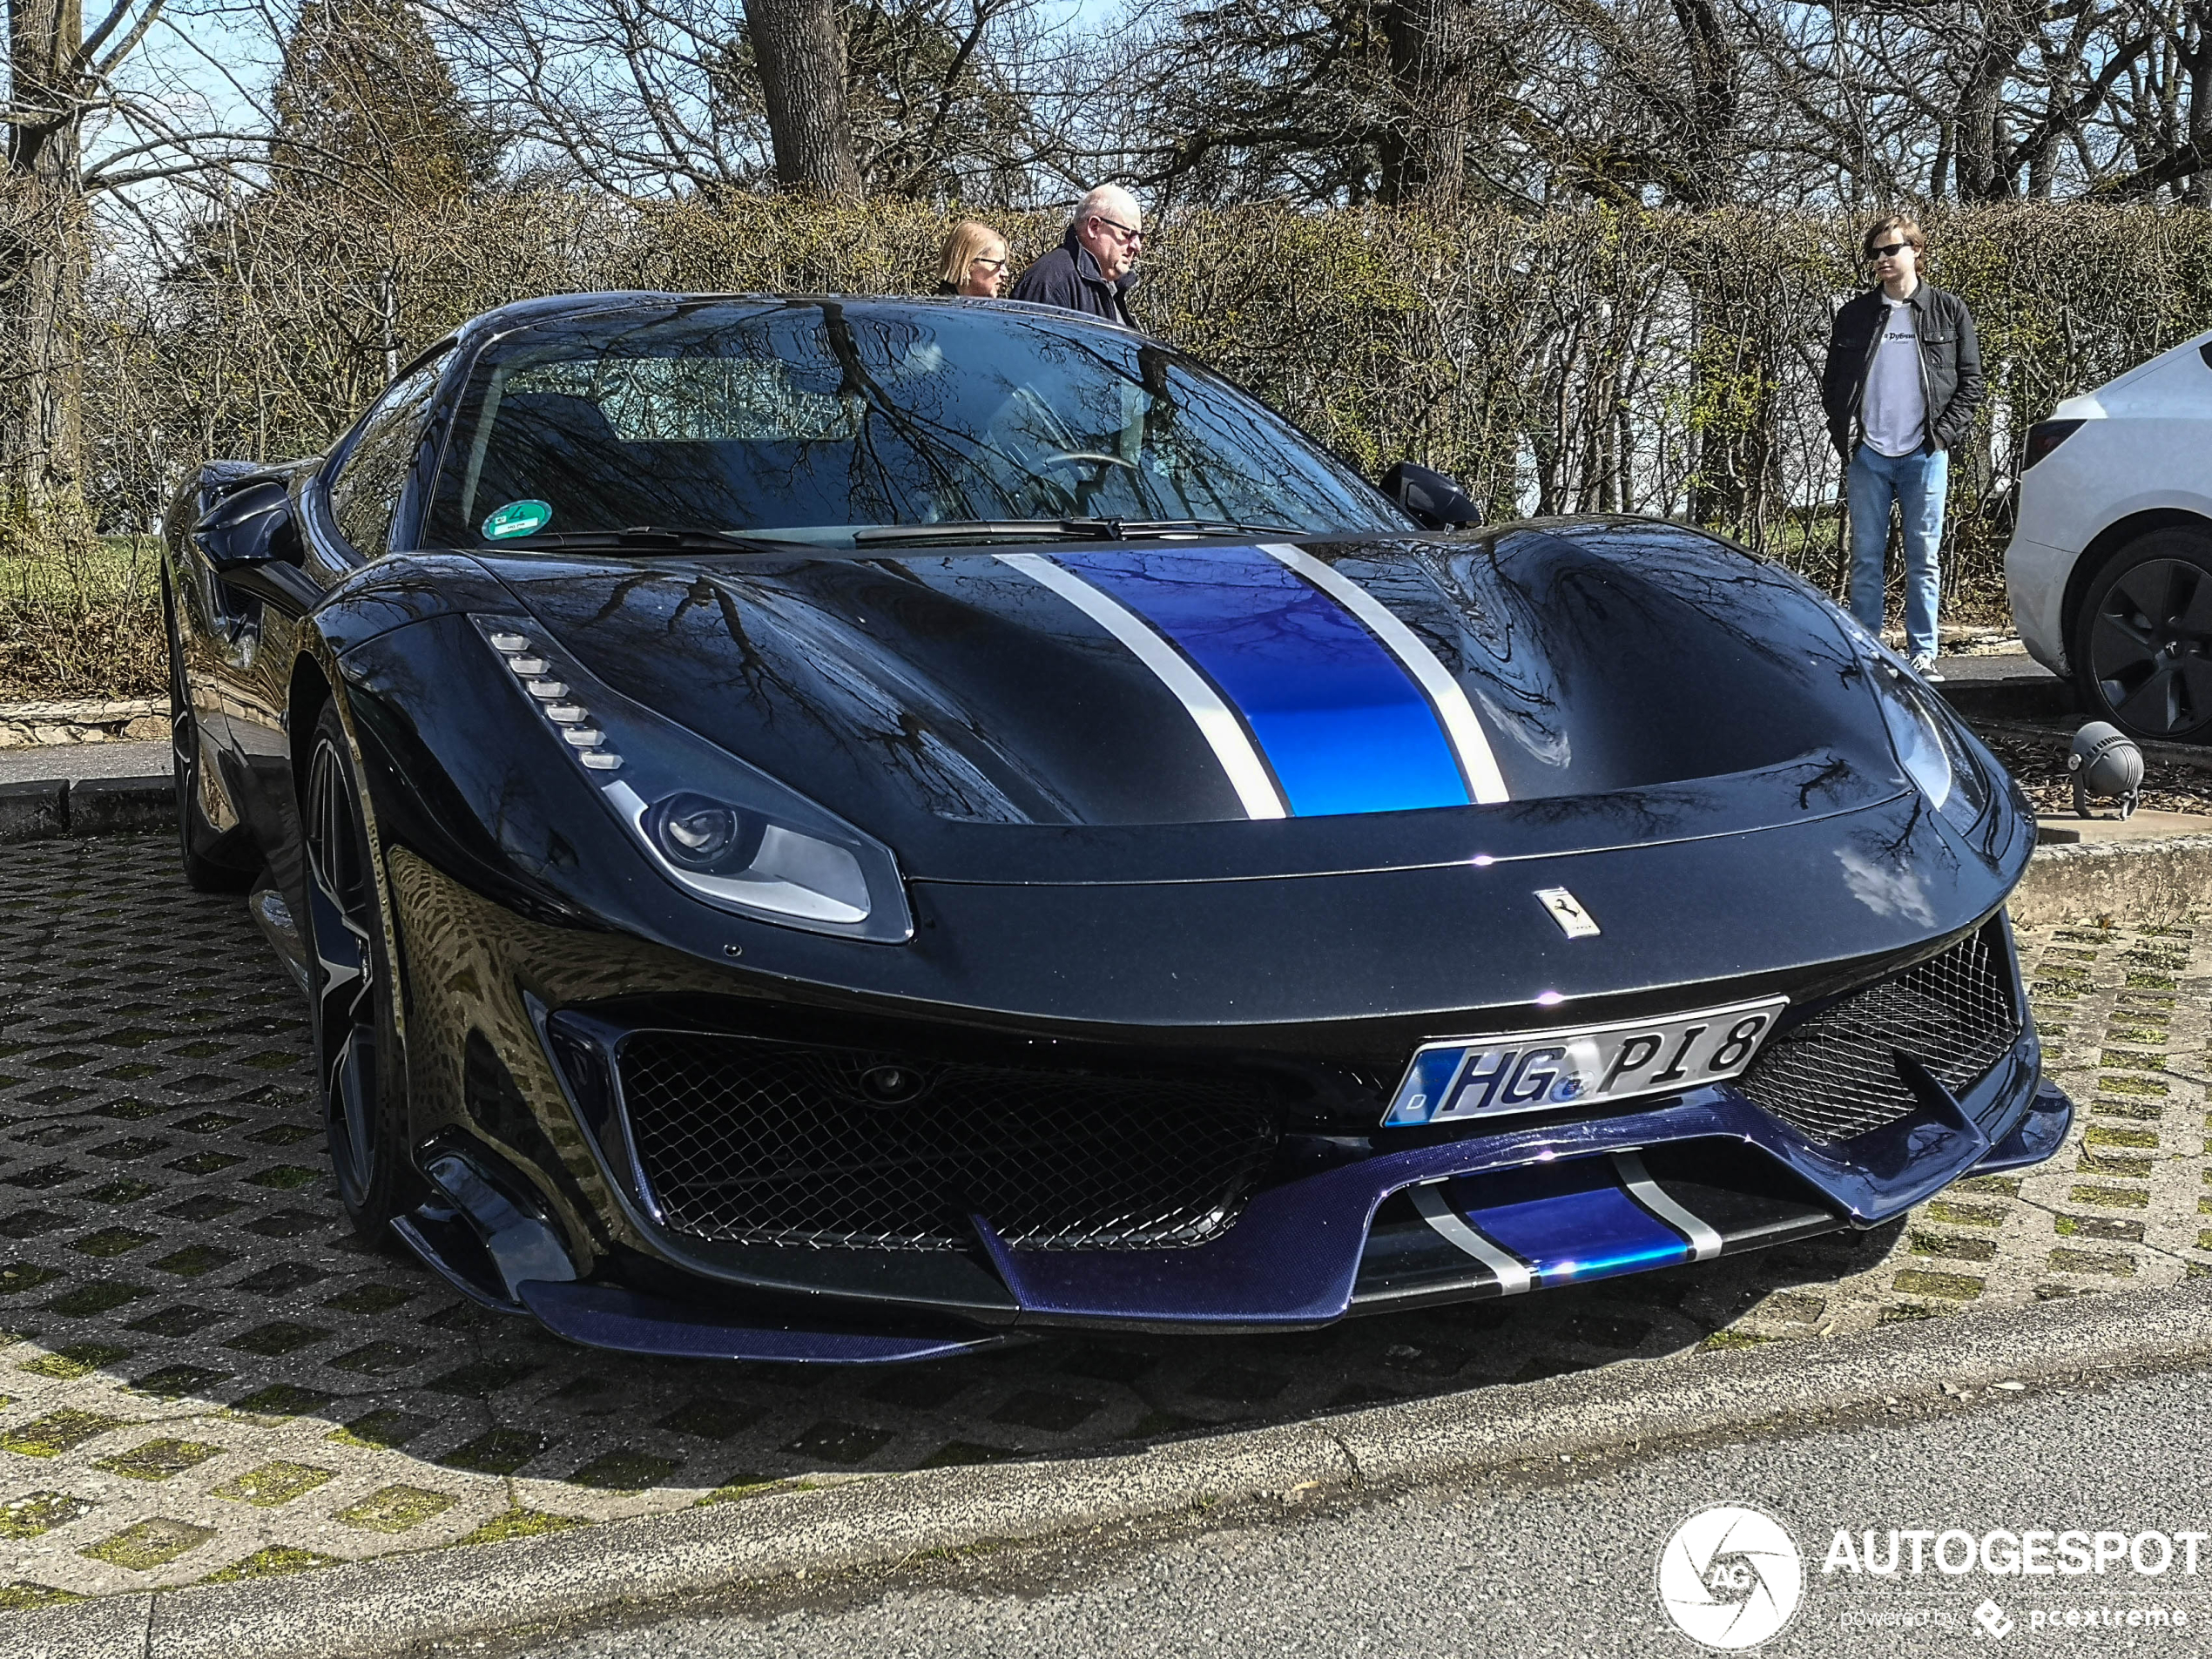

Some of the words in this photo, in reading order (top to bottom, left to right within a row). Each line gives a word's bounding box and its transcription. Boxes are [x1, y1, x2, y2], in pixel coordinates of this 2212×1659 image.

[509, 506, 525, 520] 4
[1441, 1045, 1568, 1112] HG
[1406, 1093, 1427, 1111] D
